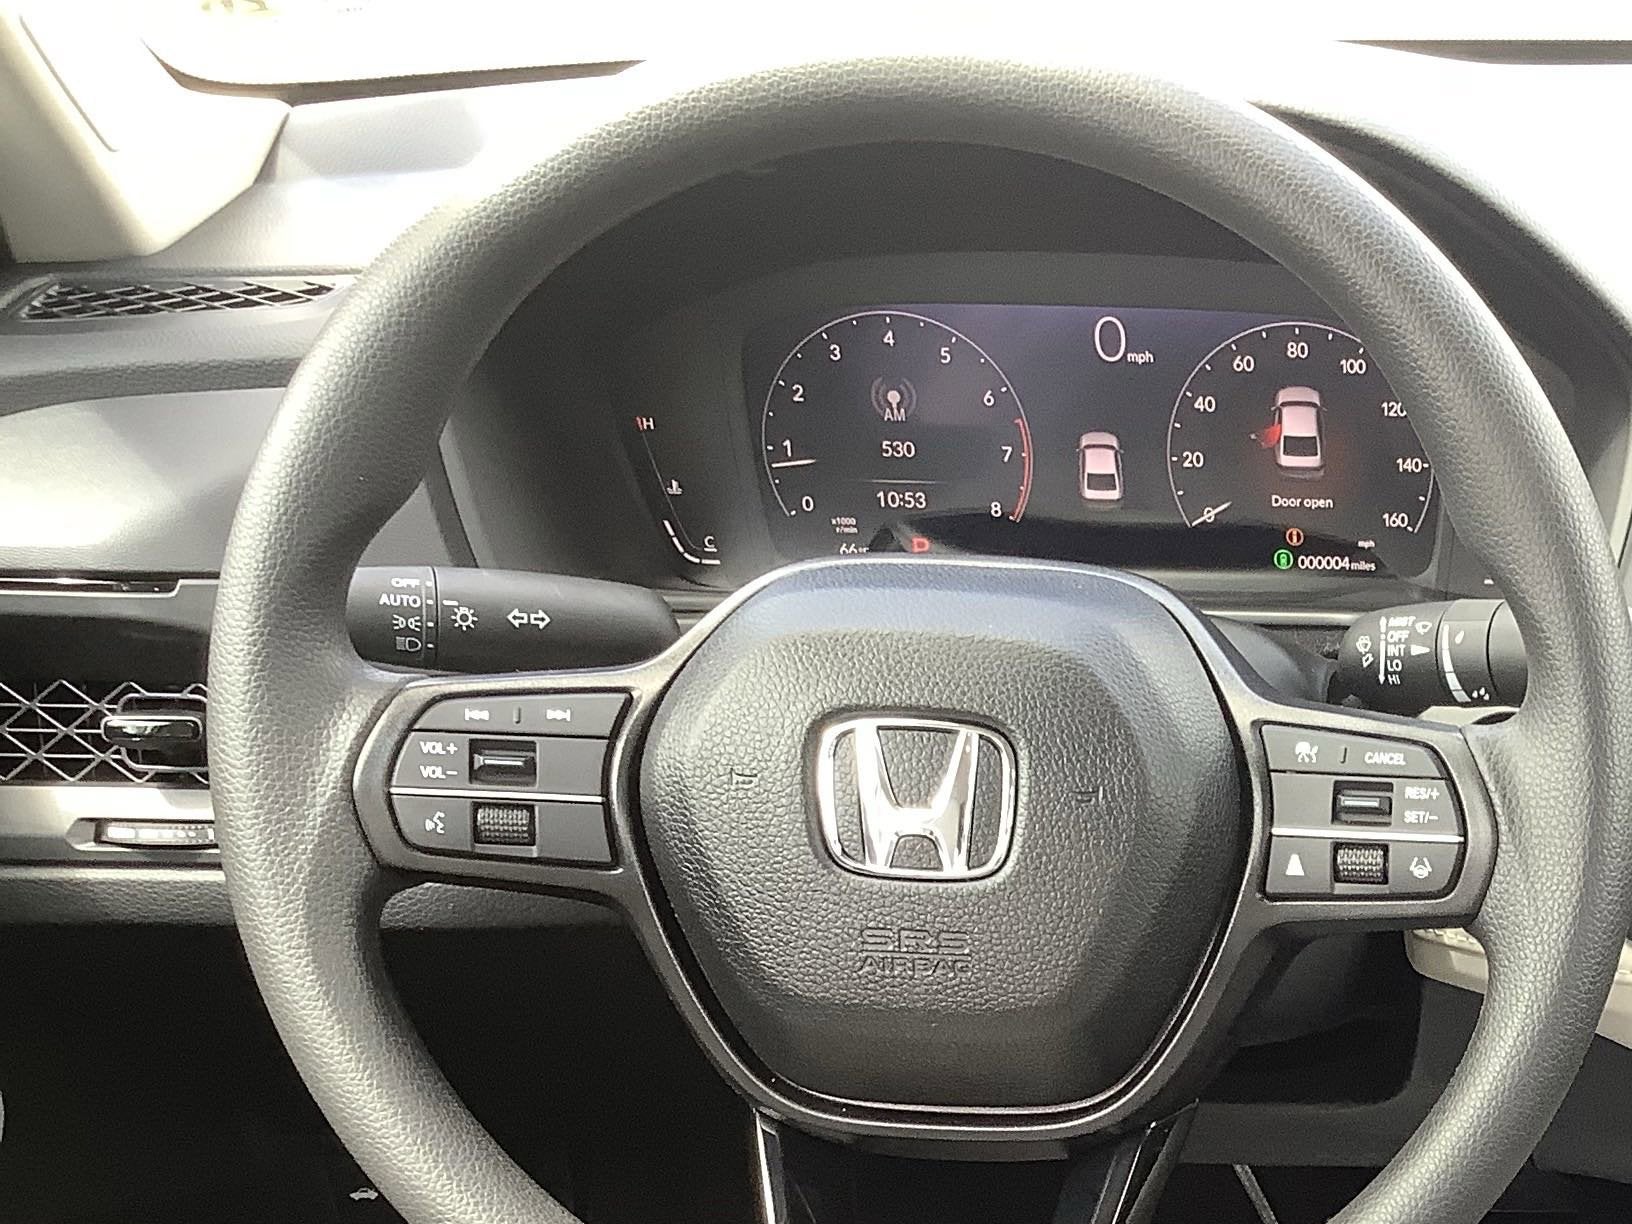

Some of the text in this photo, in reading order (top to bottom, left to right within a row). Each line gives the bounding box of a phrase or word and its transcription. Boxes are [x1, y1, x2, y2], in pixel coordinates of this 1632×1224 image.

[883, 330, 895, 347] 4
[1094, 316, 1154, 365] 0 mph
[829, 344, 842, 361] 3
[940, 347, 951, 364] 5
[1286, 341, 1309, 359] 80
[1232, 354, 1255, 373] 60
[1339, 358, 1367, 376] 100
[791, 384, 805, 403] 2
[982, 390, 995, 407] 6
[1193, 395, 1217, 413] 40
[883, 407, 906, 422] AM
[782, 439, 793, 457] 1
[881, 440, 916, 458] 530
[1000, 446, 1013, 463] 7
[1182, 451, 1204, 469] 20
[1396, 457, 1422, 473] 140
[801, 495, 814, 512] 0
[876, 490, 927, 509] 10:53
[1271, 495, 1334, 509] Door open
[990, 501, 1002, 518] 8
[1382, 512, 1409, 528] 160
[1298, 555, 1376, 572] 000004 miles
[390, 577, 421, 589] OFF
[378, 593, 422, 608] AUTO
[1386, 629, 1410, 643] OFF
[1387, 644, 1406, 657] INT
[1386, 659, 1403, 672] LO
[1387, 673, 1401, 685] HI
[1364, 751, 1407, 766] CANCEL
[860, 927, 970, 954] SRS
